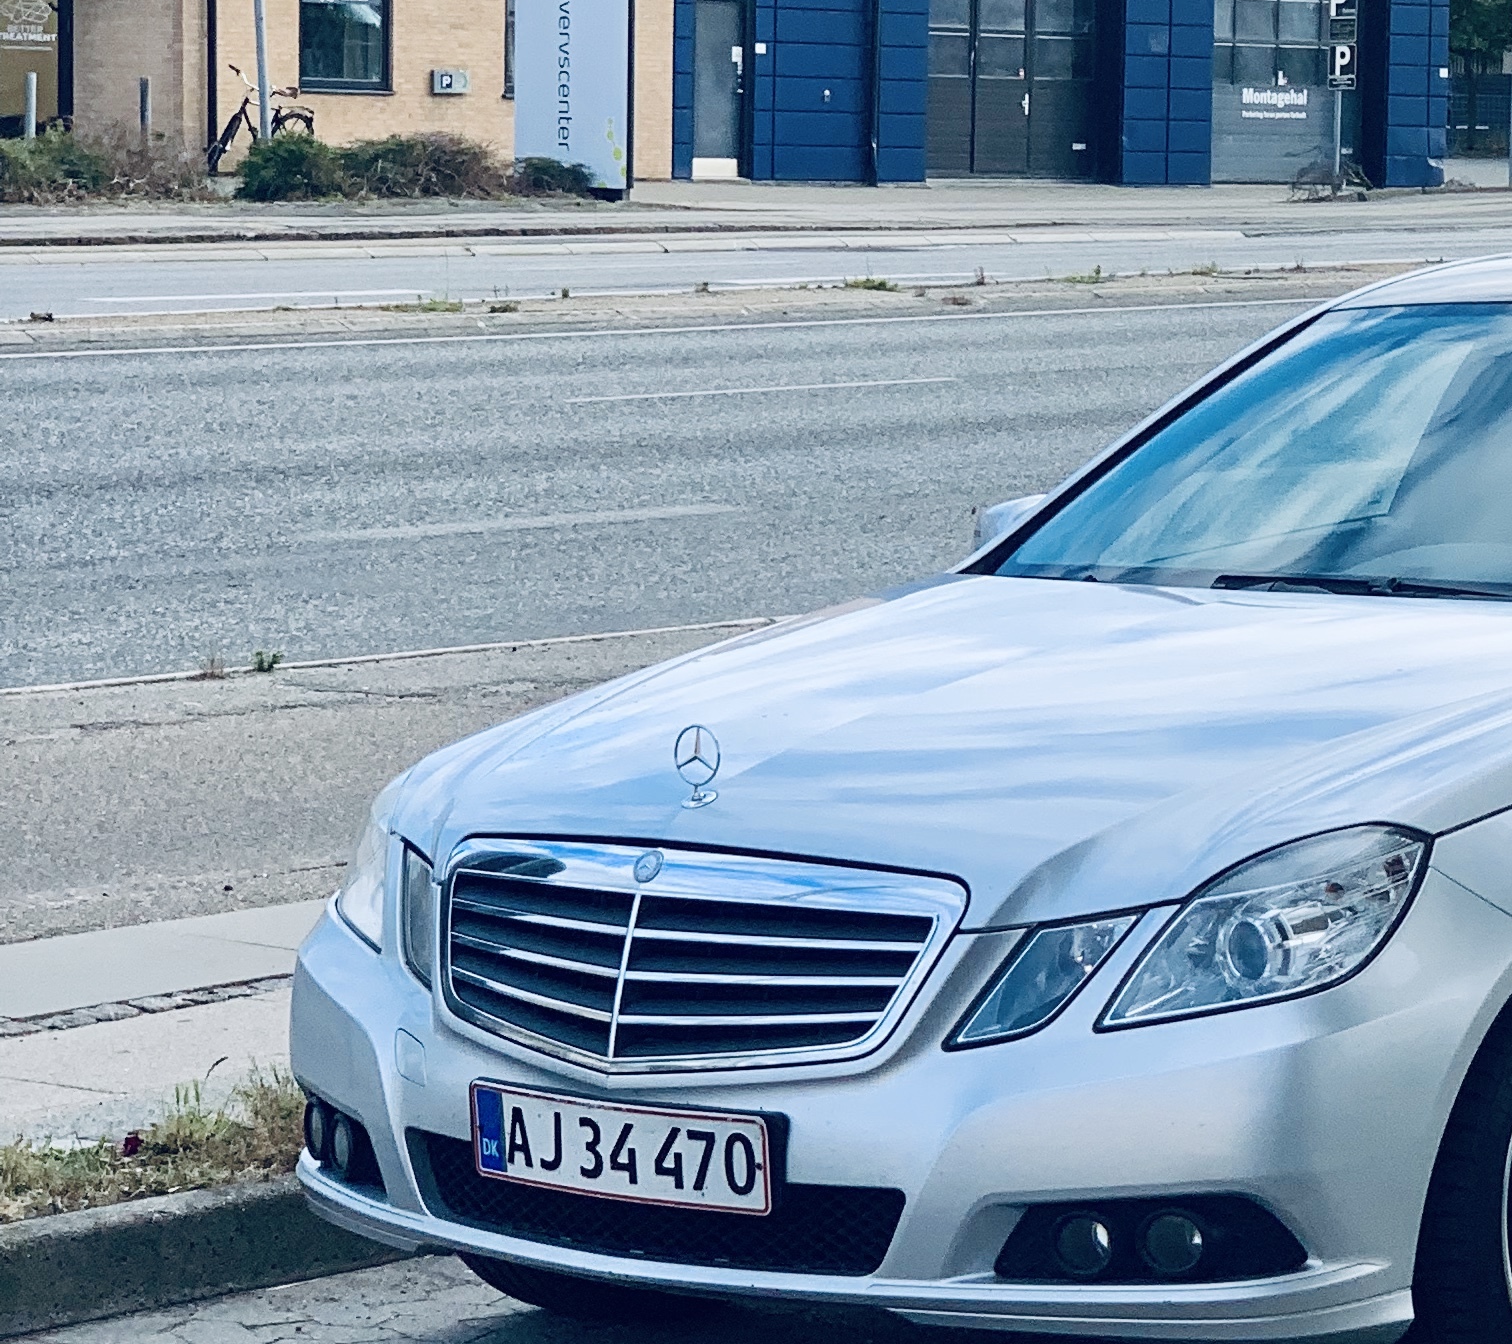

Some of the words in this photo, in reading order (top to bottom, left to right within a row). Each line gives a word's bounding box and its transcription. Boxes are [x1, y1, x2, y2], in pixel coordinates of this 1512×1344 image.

[1335, 46, 1351, 76] P
[442, 75, 451, 87] P
[1242, 88, 1307, 108] Montagehal
[482, 1137, 499, 1158] DK
[507, 1107, 562, 1171] AJ
[579, 1117, 638, 1185] 34
[654, 1127, 756, 1196] 470
